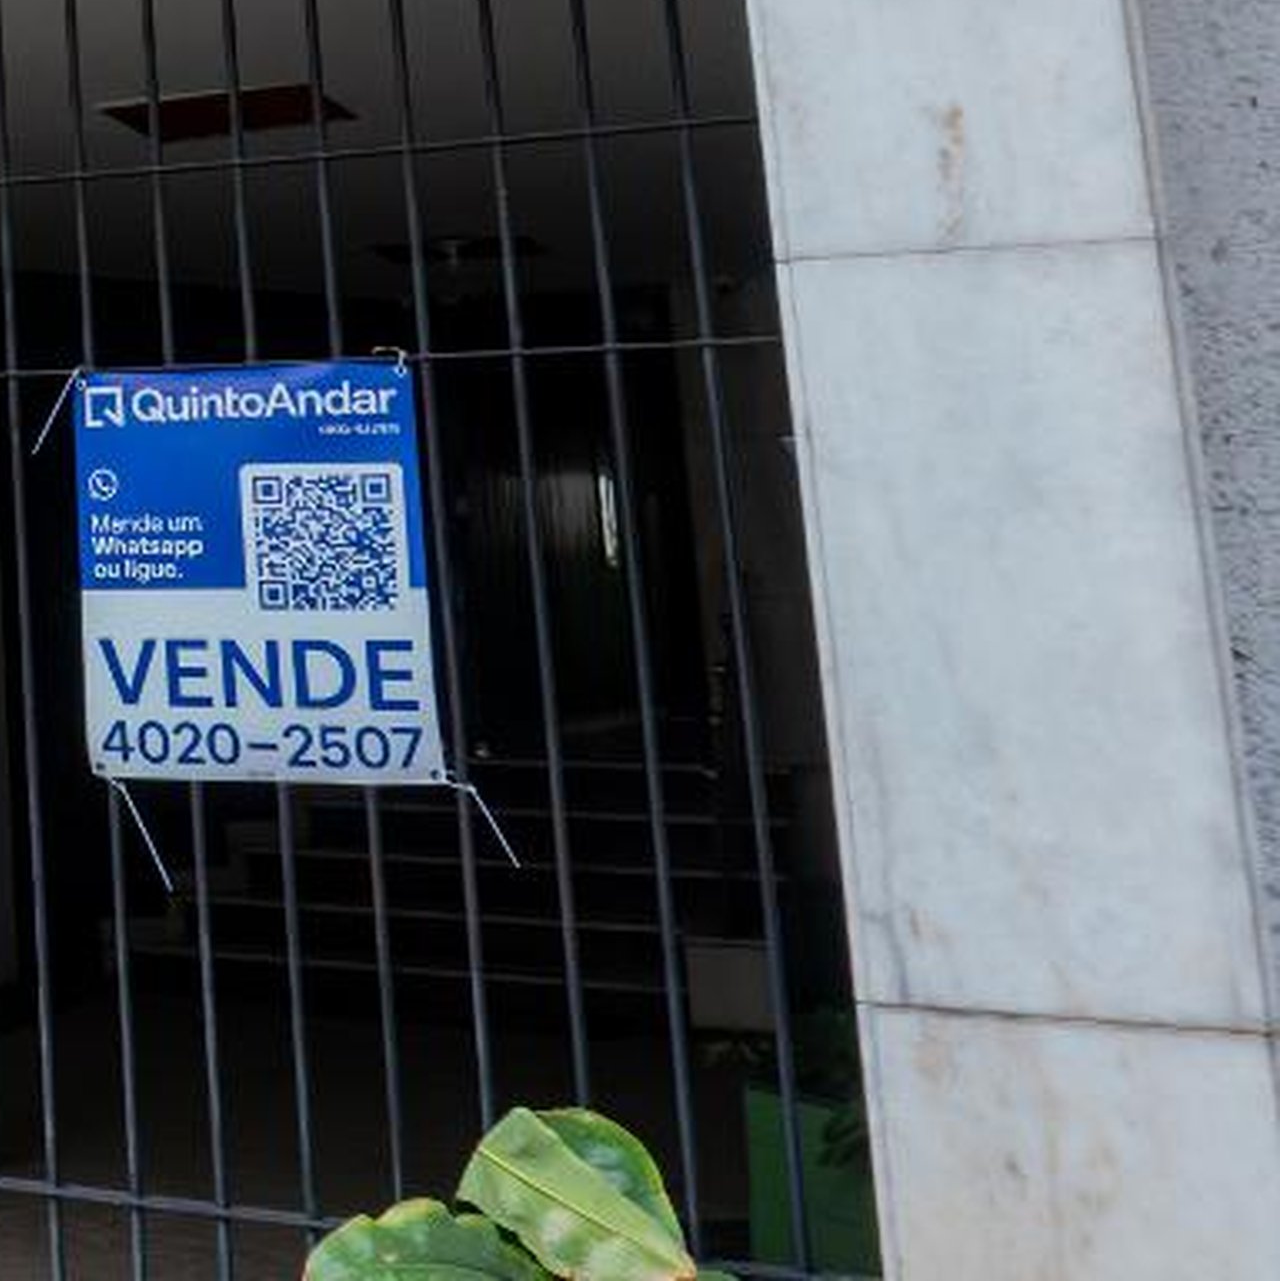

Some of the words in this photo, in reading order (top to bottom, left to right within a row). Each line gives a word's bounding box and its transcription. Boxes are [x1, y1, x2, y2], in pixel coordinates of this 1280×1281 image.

[131, 379, 398, 424] QuintoAndar
[90, 512, 165, 534] Mande
[167, 516, 204, 533] um
[90, 536, 204, 560] Whatsapp
[93, 562, 121, 579] ou
[97, 638, 421, 712] VENDE
[101, 719, 424, 770] 4020-2507
